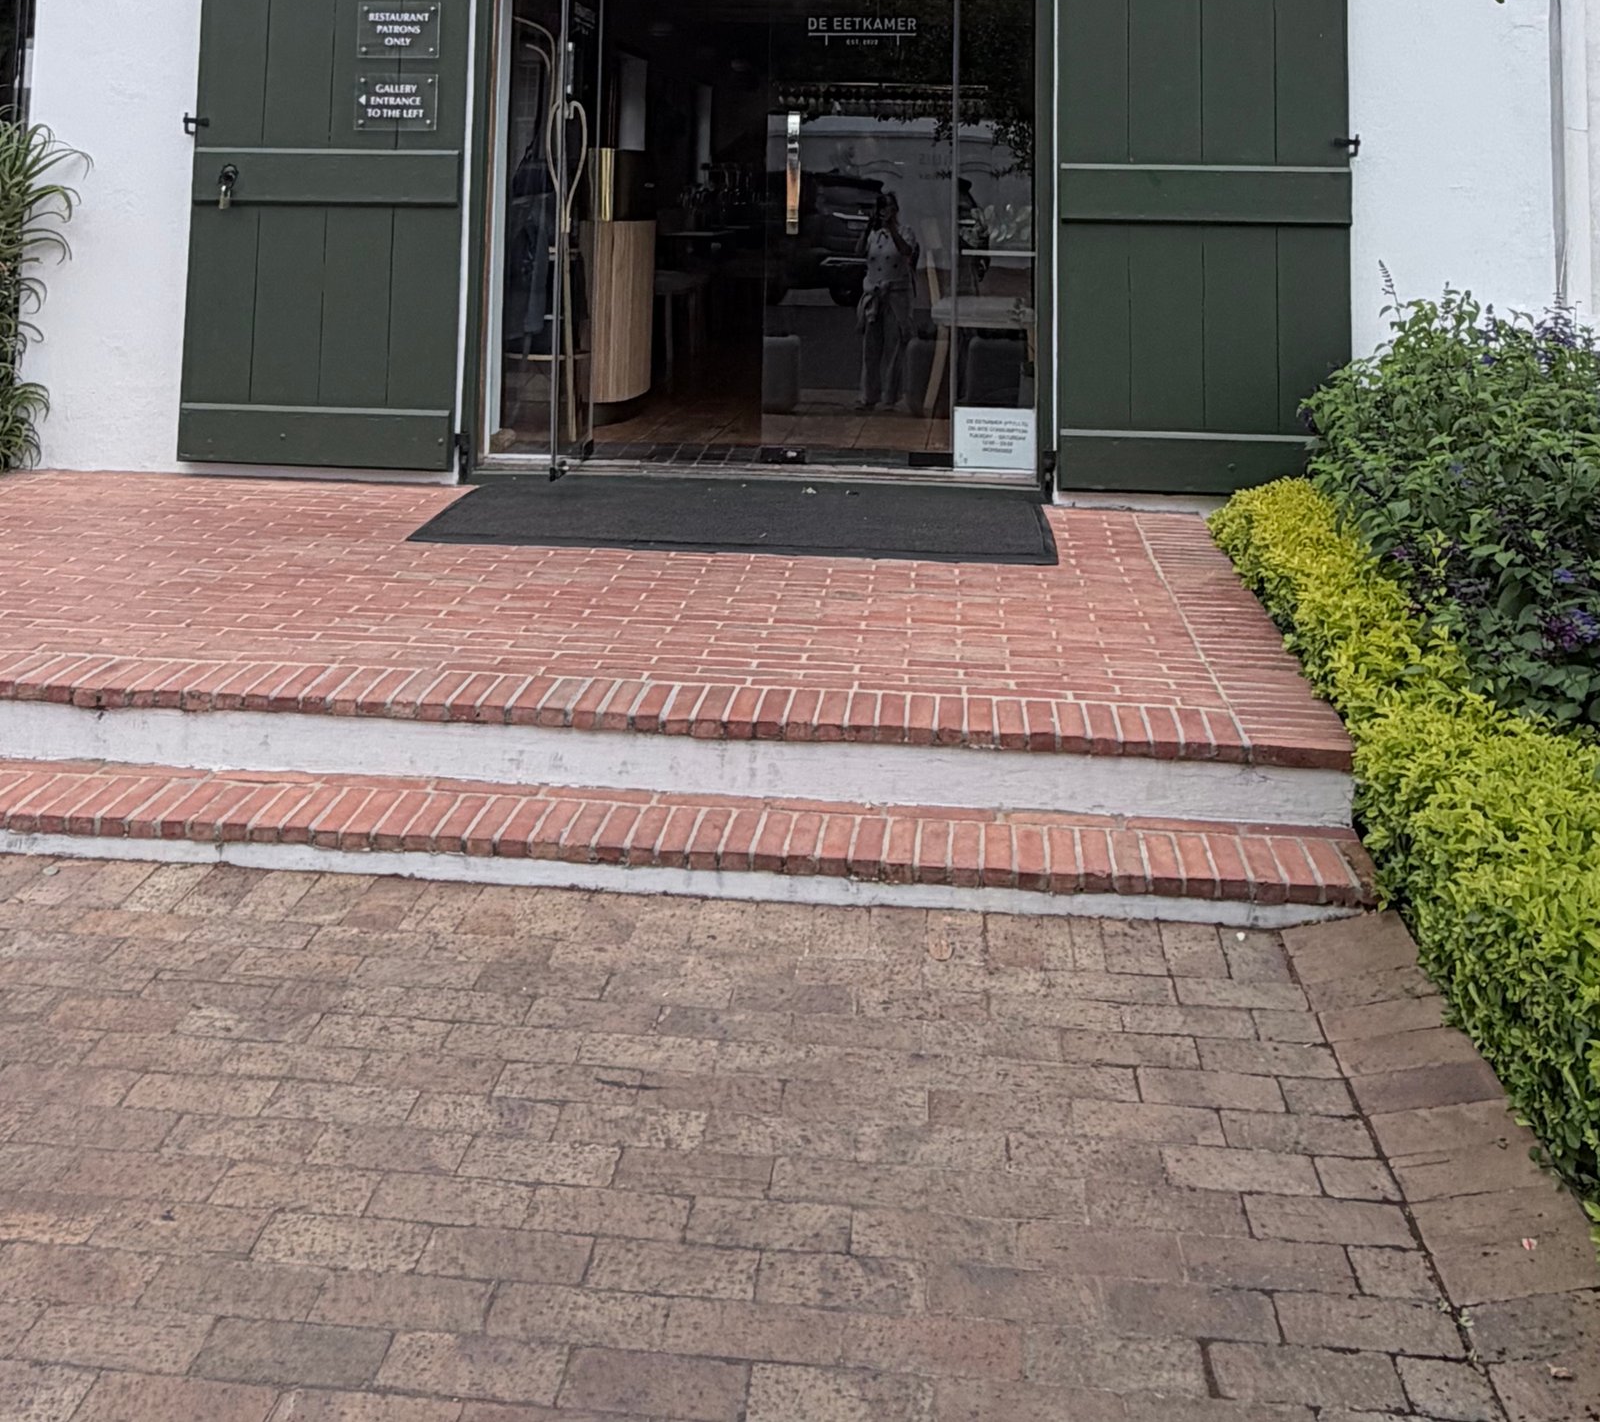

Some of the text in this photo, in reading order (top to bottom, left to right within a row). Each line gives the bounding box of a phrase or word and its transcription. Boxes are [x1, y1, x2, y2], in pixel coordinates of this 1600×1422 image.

[368, 12, 430, 22] RESTAURANT
[807, 17, 917, 30] DE EETKAMER
[376, 25, 421, 34] PATRONS
[384, 37, 412, 46] ONLY
[375, 84, 417, 93] GALLERY
[370, 96, 422, 106] ENTRANCE
[366, 108, 424, 118] TO THE LEFT
